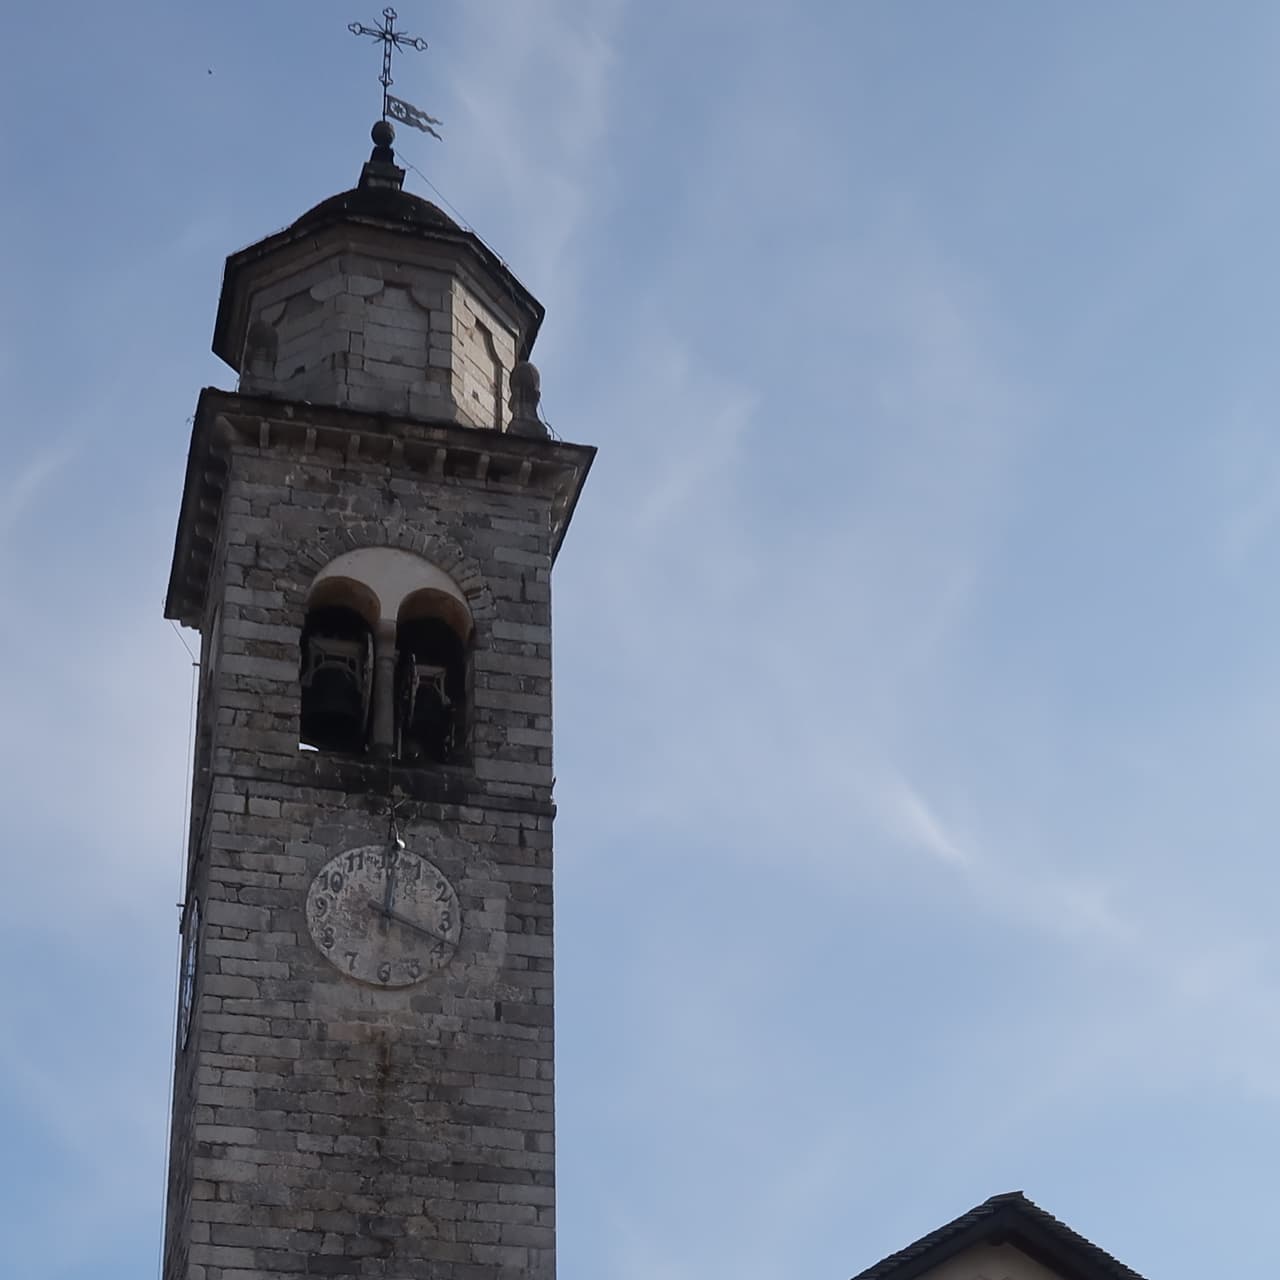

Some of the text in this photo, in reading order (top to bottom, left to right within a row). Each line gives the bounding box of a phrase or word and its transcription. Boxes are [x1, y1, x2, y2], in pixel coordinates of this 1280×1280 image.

[345, 852, 365, 873] 11
[320, 872, 343, 893] 10
[435, 881, 451, 903] 2
[315, 898, 327, 918] 9
[438, 911, 452, 932] 3
[321, 927, 335, 949] 8
[430, 942, 445, 960] 4
[345, 952, 358, 972] 7
[377, 962, 391, 983] 6
[408, 959, 421, 979] 5
